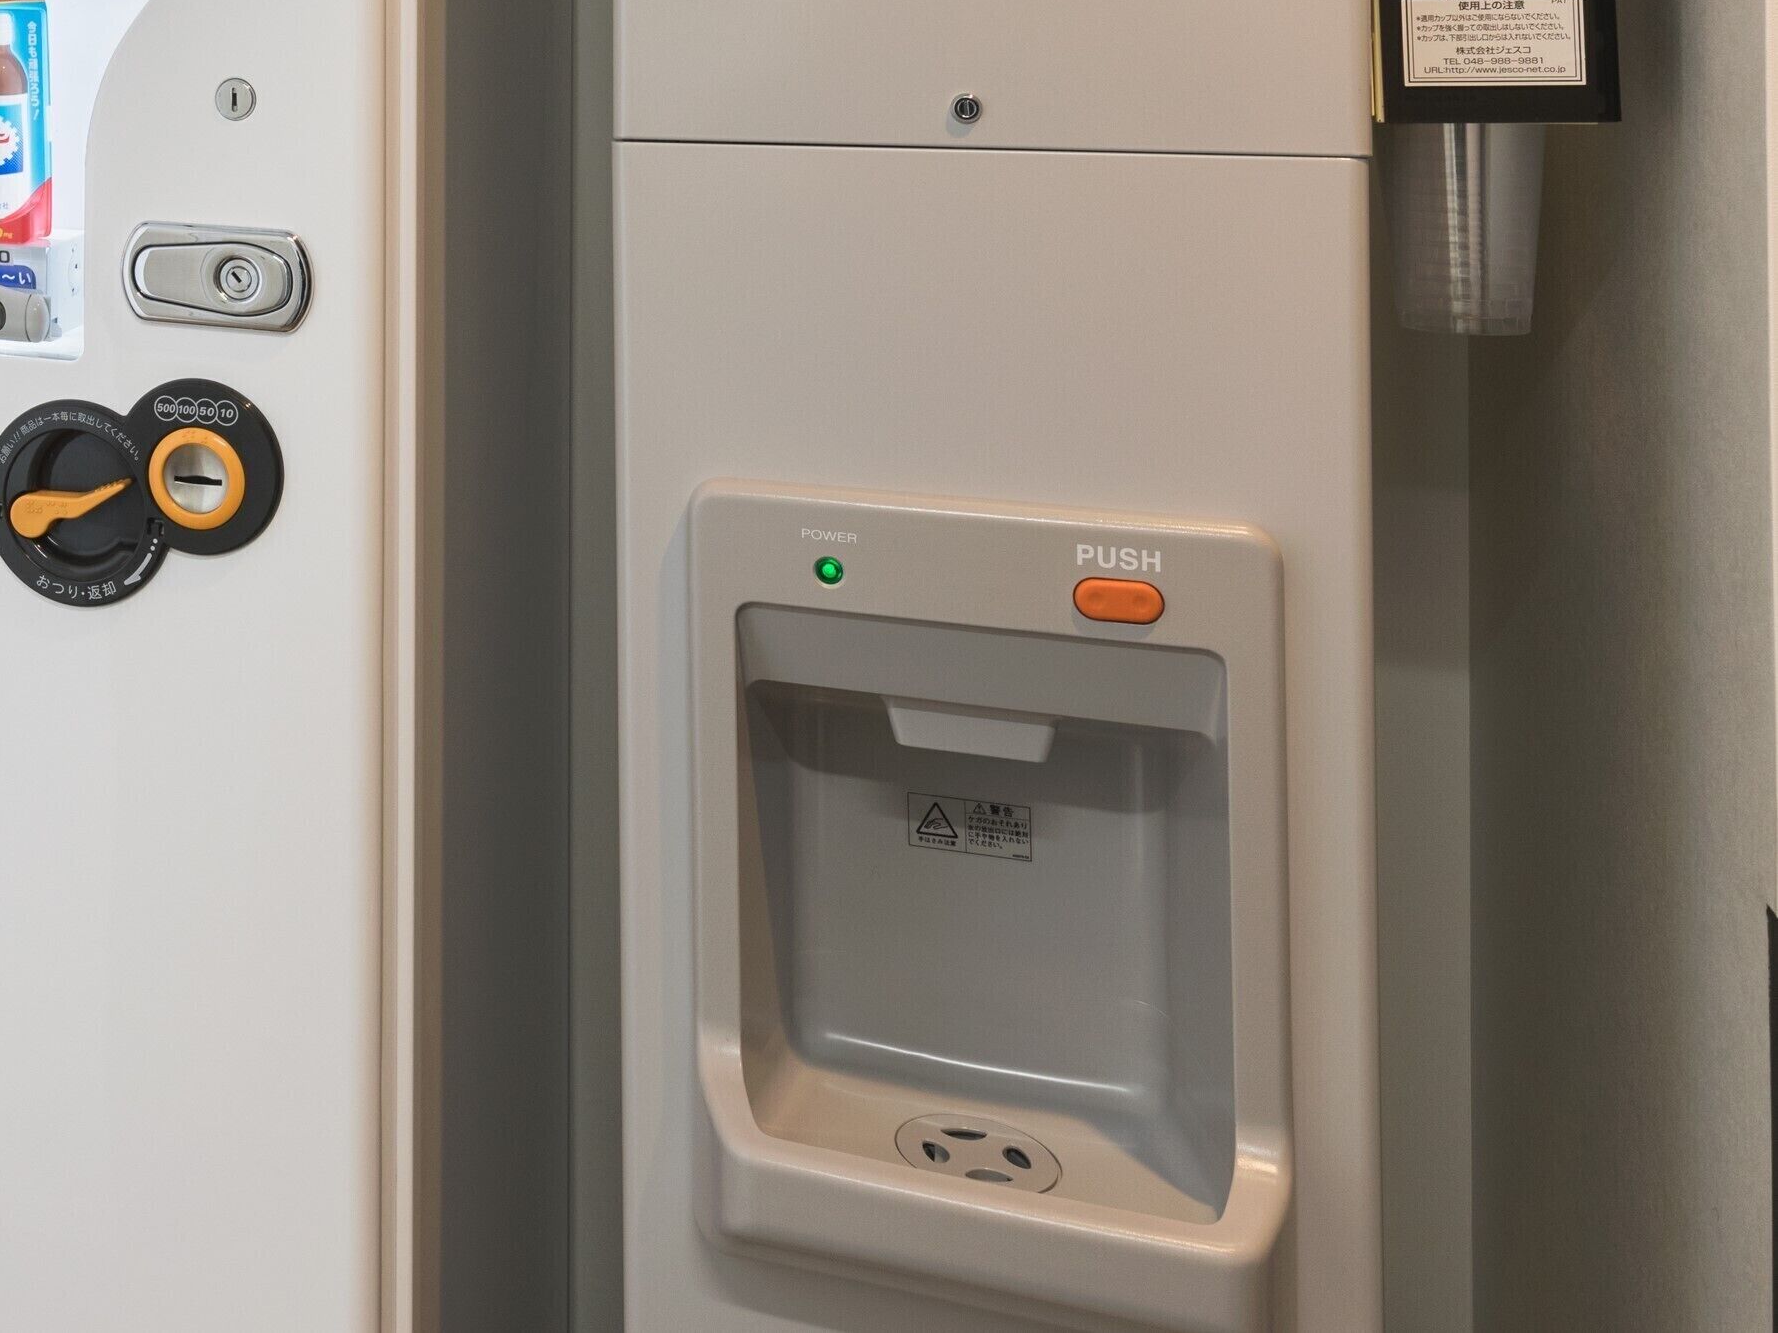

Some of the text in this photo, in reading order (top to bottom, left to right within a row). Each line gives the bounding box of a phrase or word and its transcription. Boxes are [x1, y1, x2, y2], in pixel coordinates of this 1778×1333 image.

[1459, 0, 1525, 11] 使用上の注意
[1456, 46, 1532, 55] 株式会社ジェスコ
[157, 403, 234, 419] 500 100 50 10
[801, 527, 857, 544] POWER
[1076, 543, 1161, 572] PUSH
[36, 574, 117, 601] おつり・返却
[990, 804, 1013, 817] 警告
